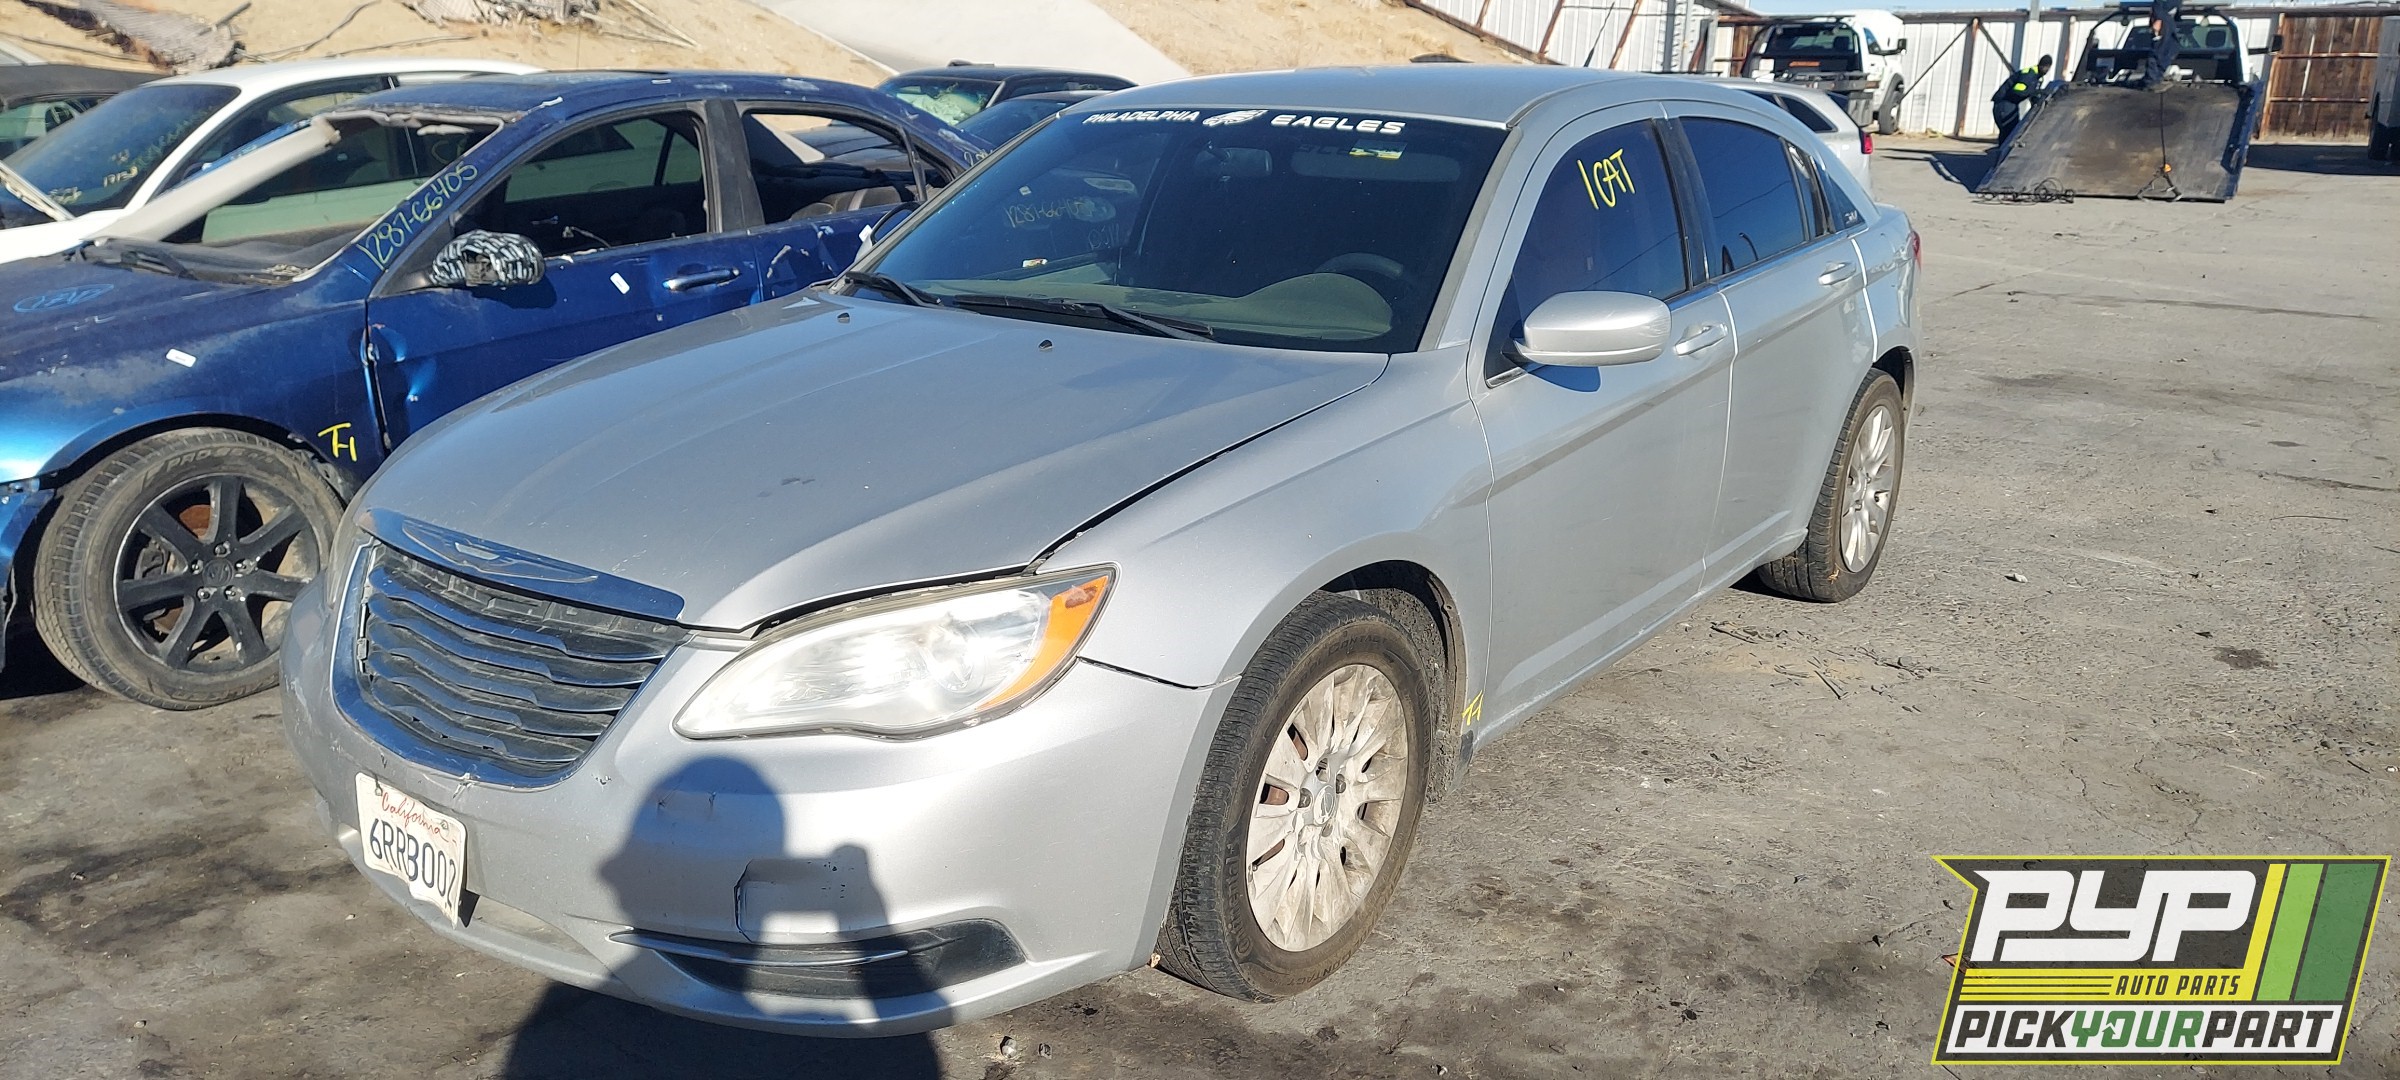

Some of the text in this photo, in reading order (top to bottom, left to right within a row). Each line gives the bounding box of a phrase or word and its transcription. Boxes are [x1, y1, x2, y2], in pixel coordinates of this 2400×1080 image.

[1083, 110, 1406, 134] PHILADELPHIA EAGLES
[382, 792, 449, 842] California
